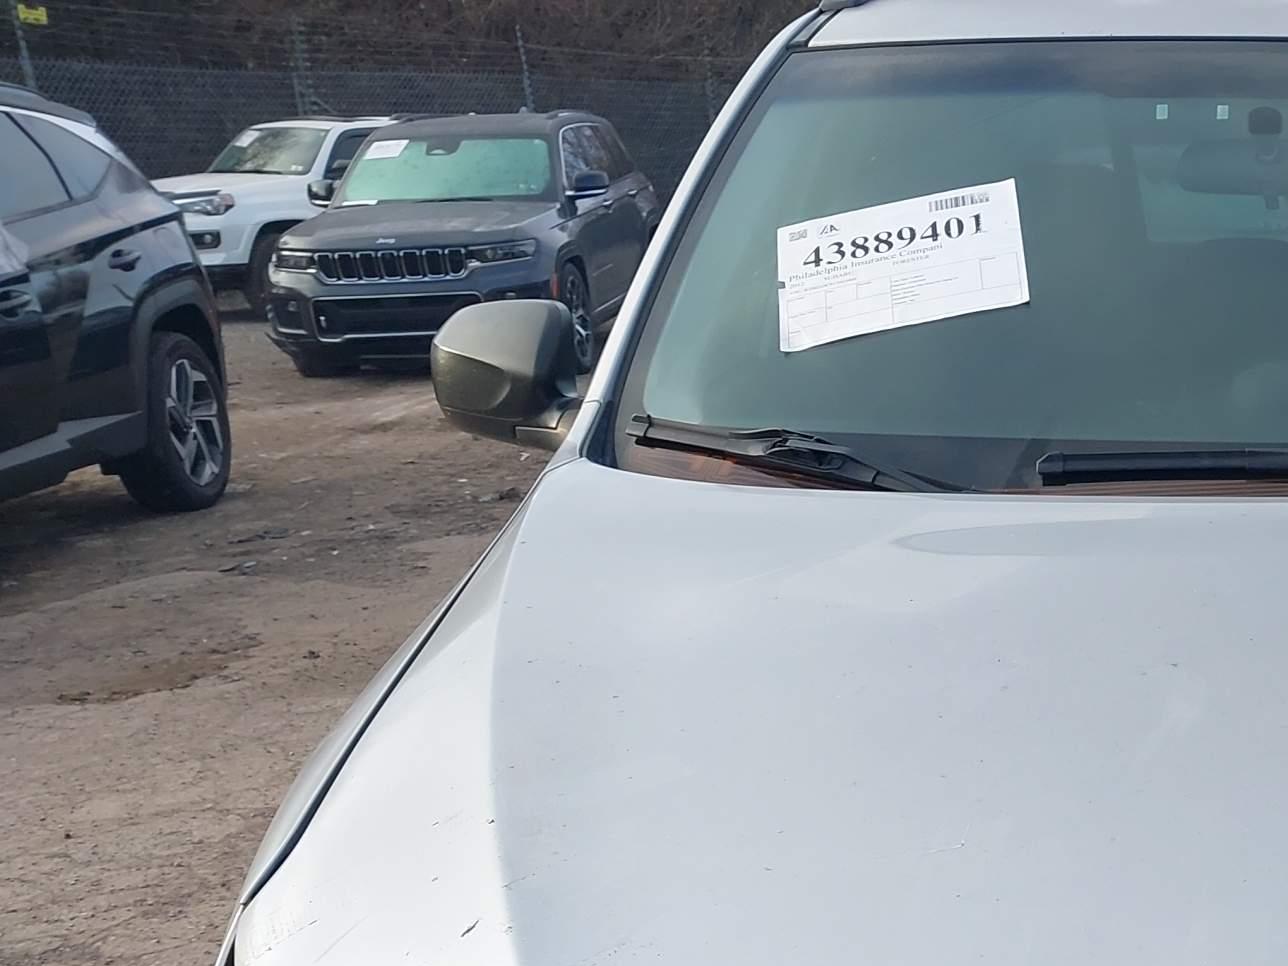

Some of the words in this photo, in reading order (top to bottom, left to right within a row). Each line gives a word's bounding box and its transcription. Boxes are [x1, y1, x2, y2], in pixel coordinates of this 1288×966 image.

[803, 213, 985, 268] 43889401
[789, 264, 848, 282] Philadelphia
[851, 253, 897, 268] Insurance
